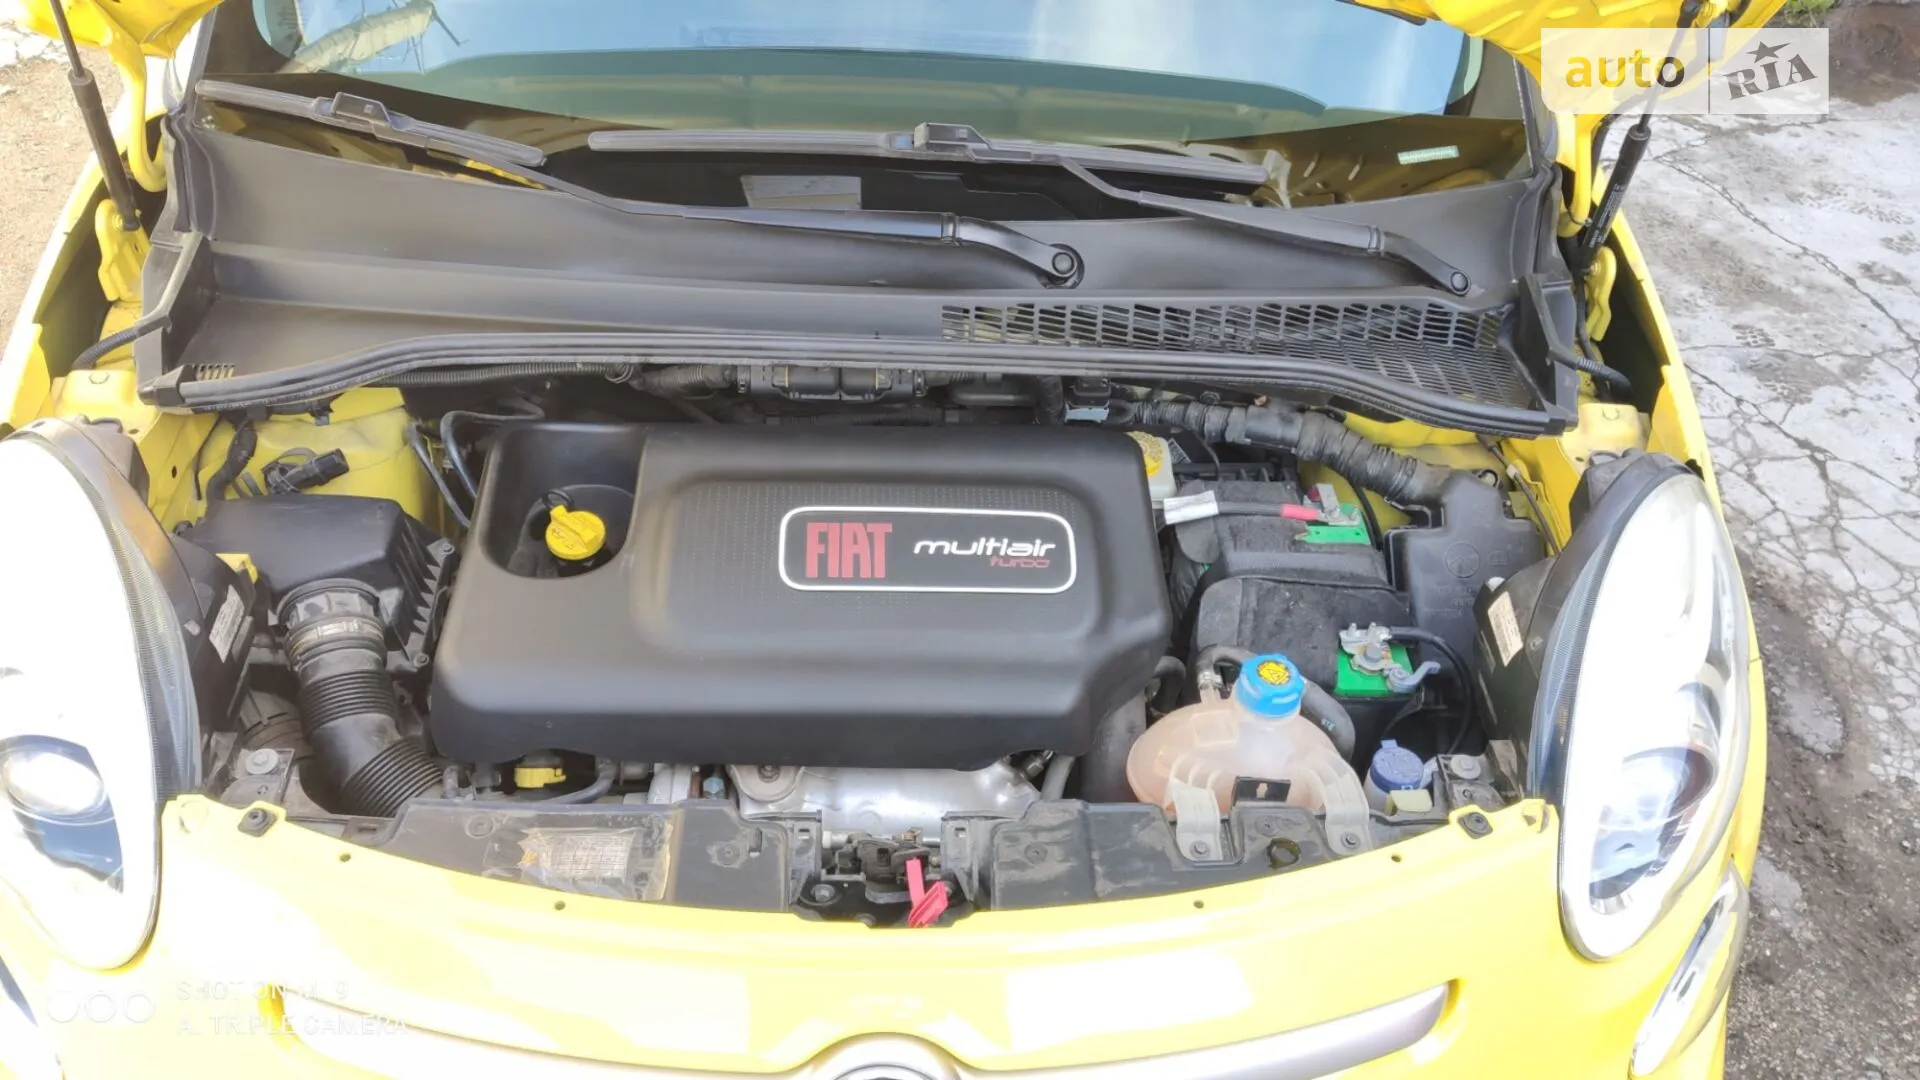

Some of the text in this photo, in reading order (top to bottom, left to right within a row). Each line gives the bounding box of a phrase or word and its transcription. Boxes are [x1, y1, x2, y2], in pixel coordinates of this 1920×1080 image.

[806, 522, 893, 578] FIAT
[914, 537, 1056, 557] multiair
[990, 556, 1050, 568] turbo
